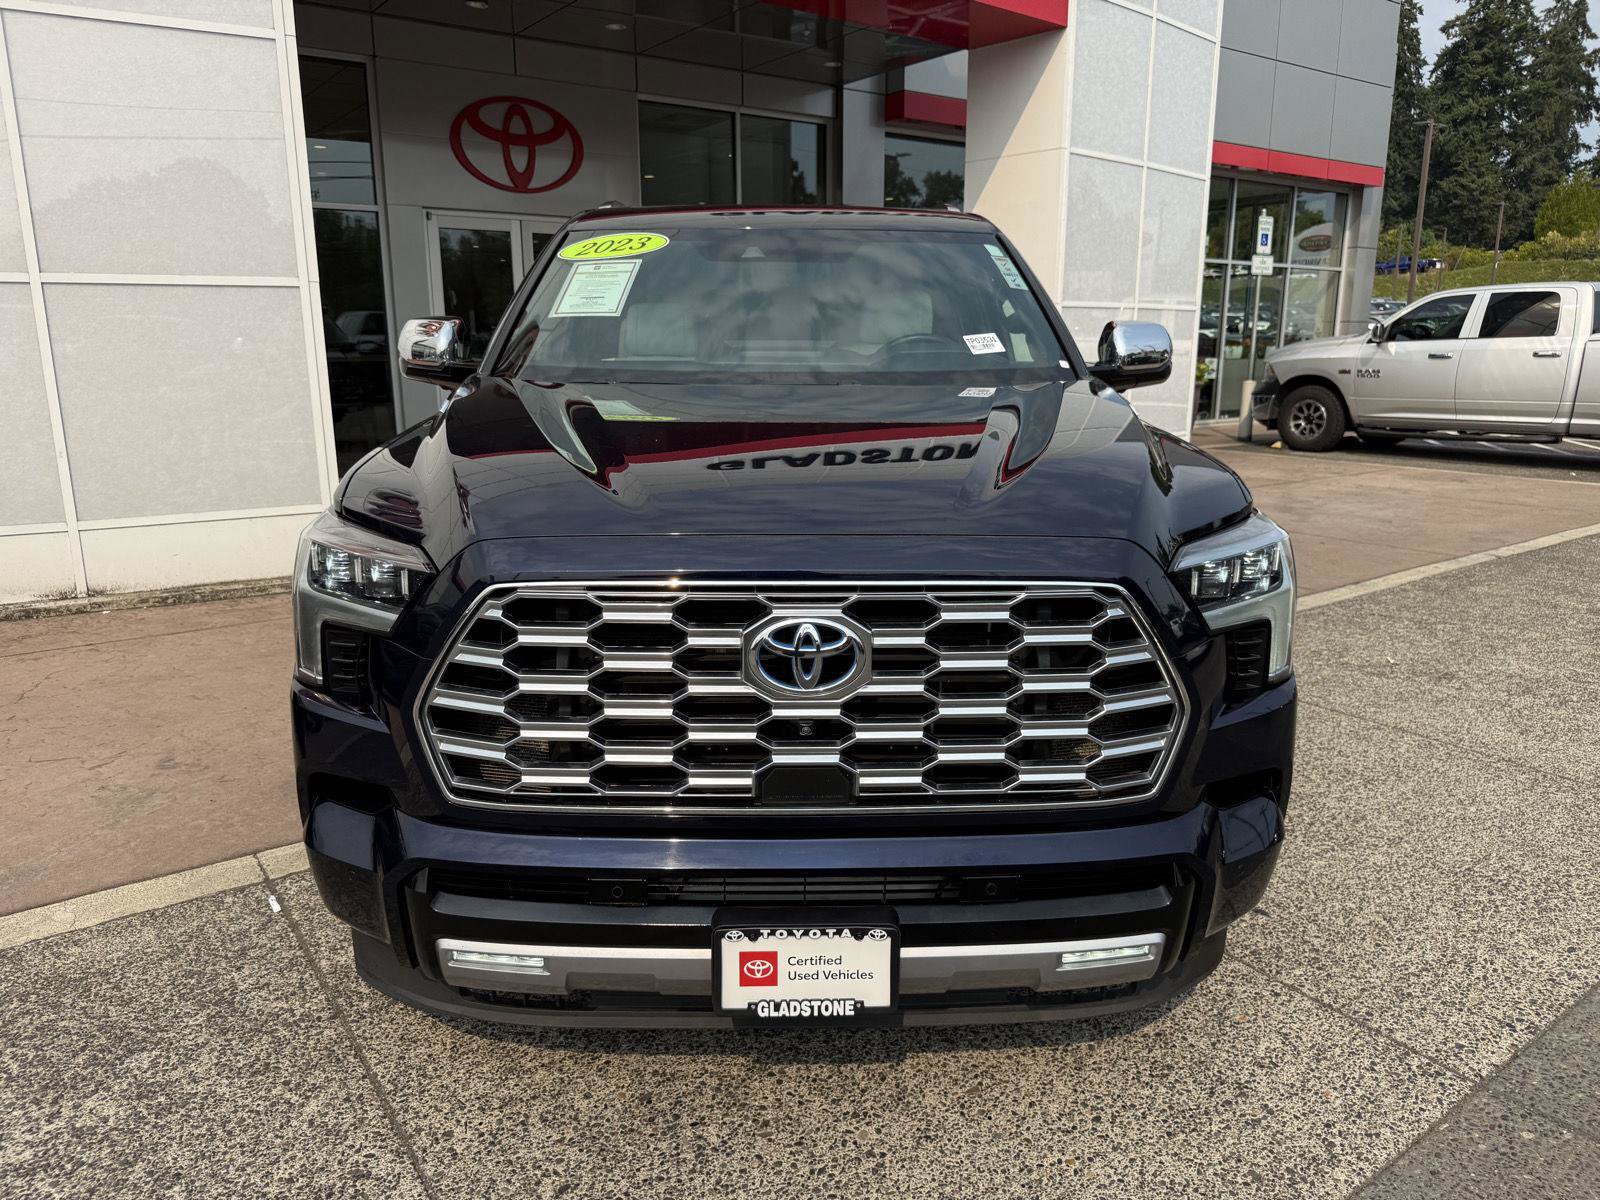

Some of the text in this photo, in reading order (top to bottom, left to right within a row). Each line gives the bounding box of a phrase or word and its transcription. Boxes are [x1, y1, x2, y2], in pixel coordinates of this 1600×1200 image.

[574, 236, 652, 257] 2023
[760, 928, 853, 939] TOYOTA
[787, 955, 842, 966] Certified
[788, 969, 874, 981] Used Vehicles
[757, 1000, 855, 1017] GLADSTONE
